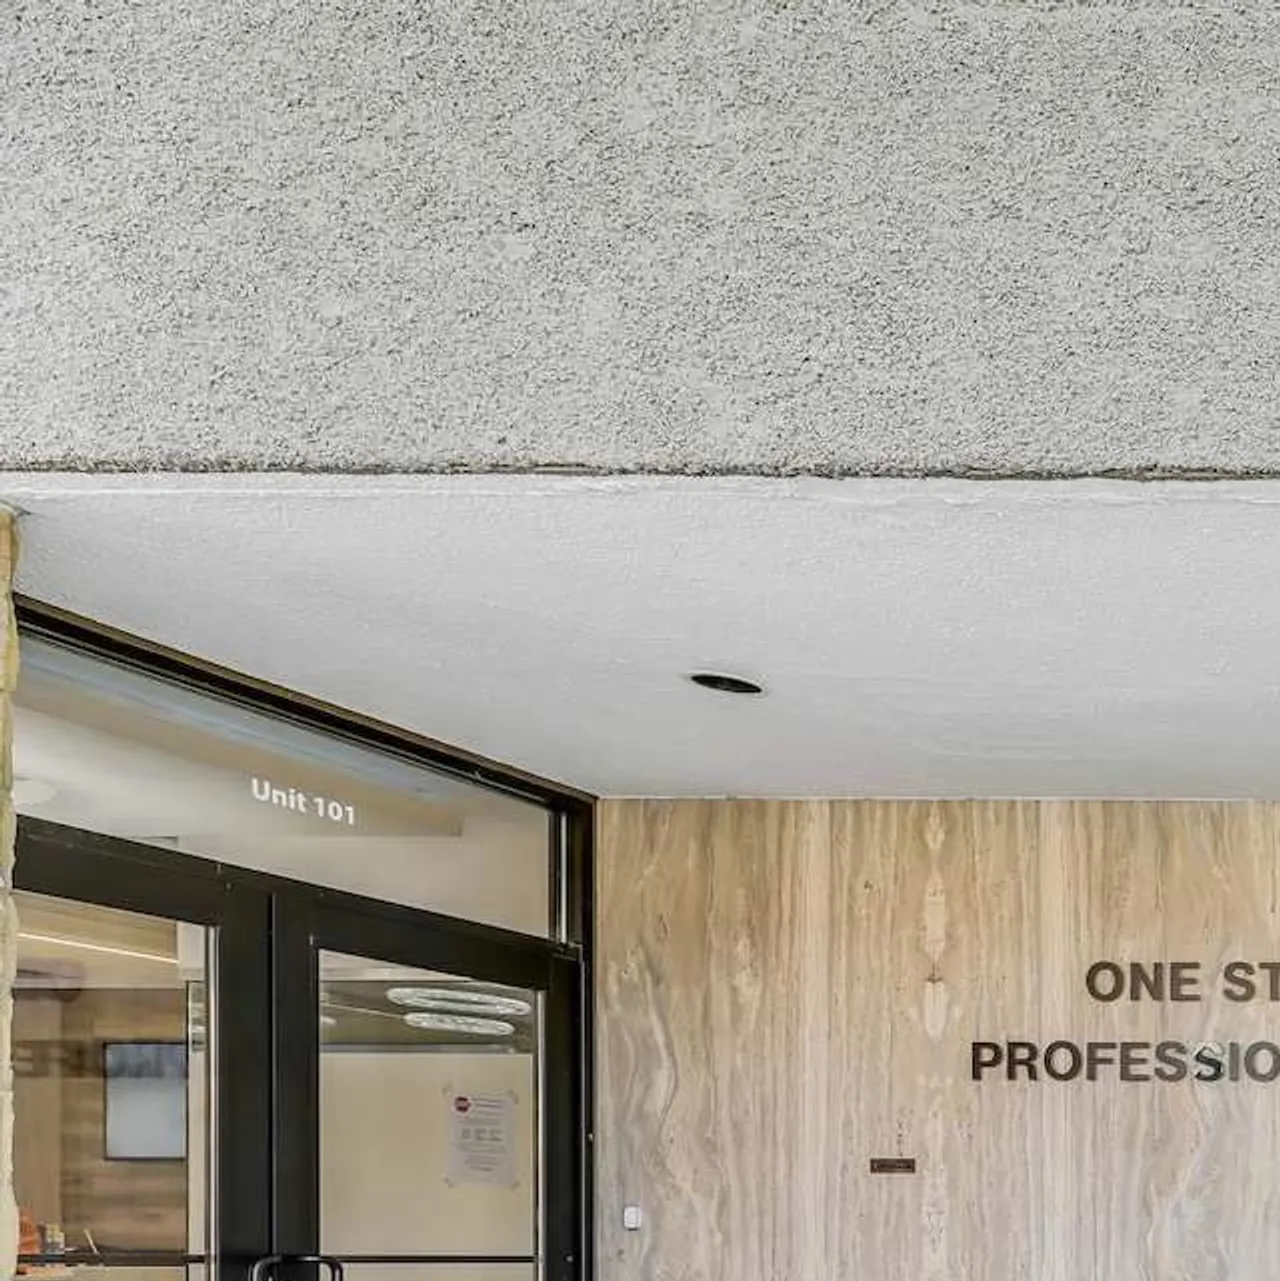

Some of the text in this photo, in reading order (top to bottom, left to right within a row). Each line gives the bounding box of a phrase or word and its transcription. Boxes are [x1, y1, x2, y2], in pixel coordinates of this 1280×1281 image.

[252, 777, 354, 825] Unit 101
[1085, 961, 1201, 1001] ONE
